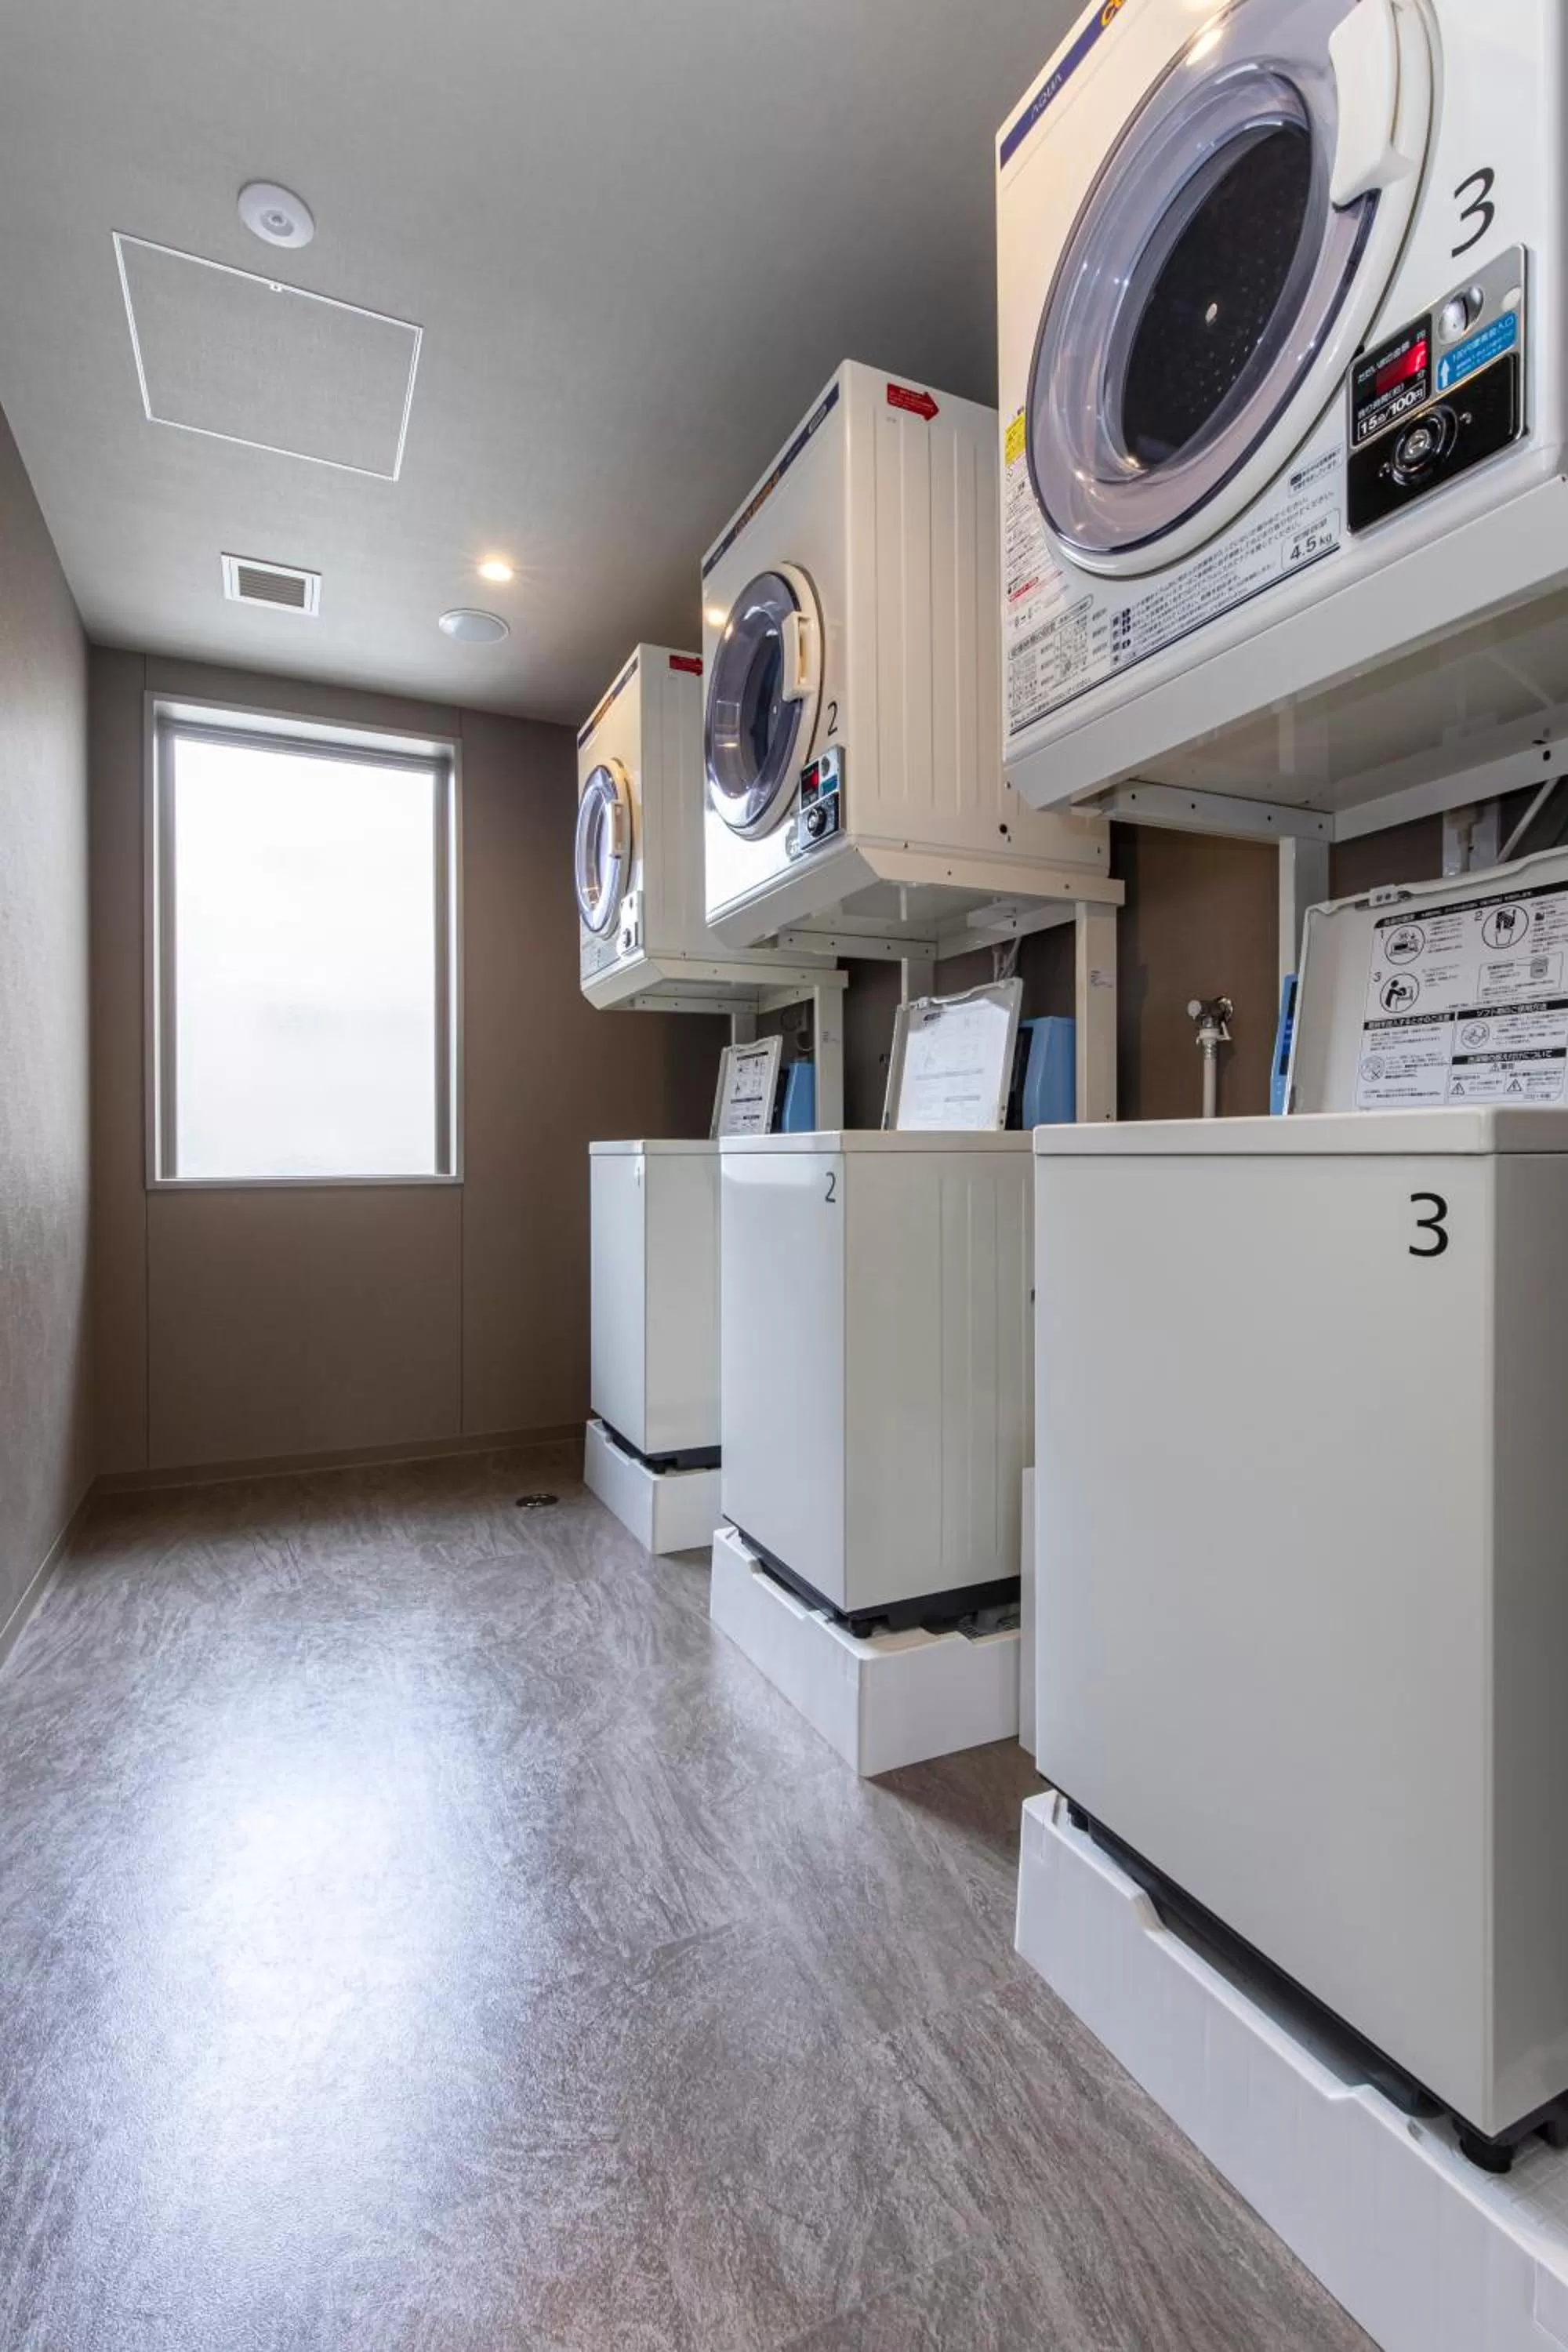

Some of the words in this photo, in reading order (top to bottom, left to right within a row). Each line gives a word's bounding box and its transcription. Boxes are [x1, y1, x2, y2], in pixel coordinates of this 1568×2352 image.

[1451, 166, 1495, 258] 3
[827, 701, 838, 737] 2
[825, 1171, 837, 1203] 2
[1409, 1192, 1449, 1257] 3
